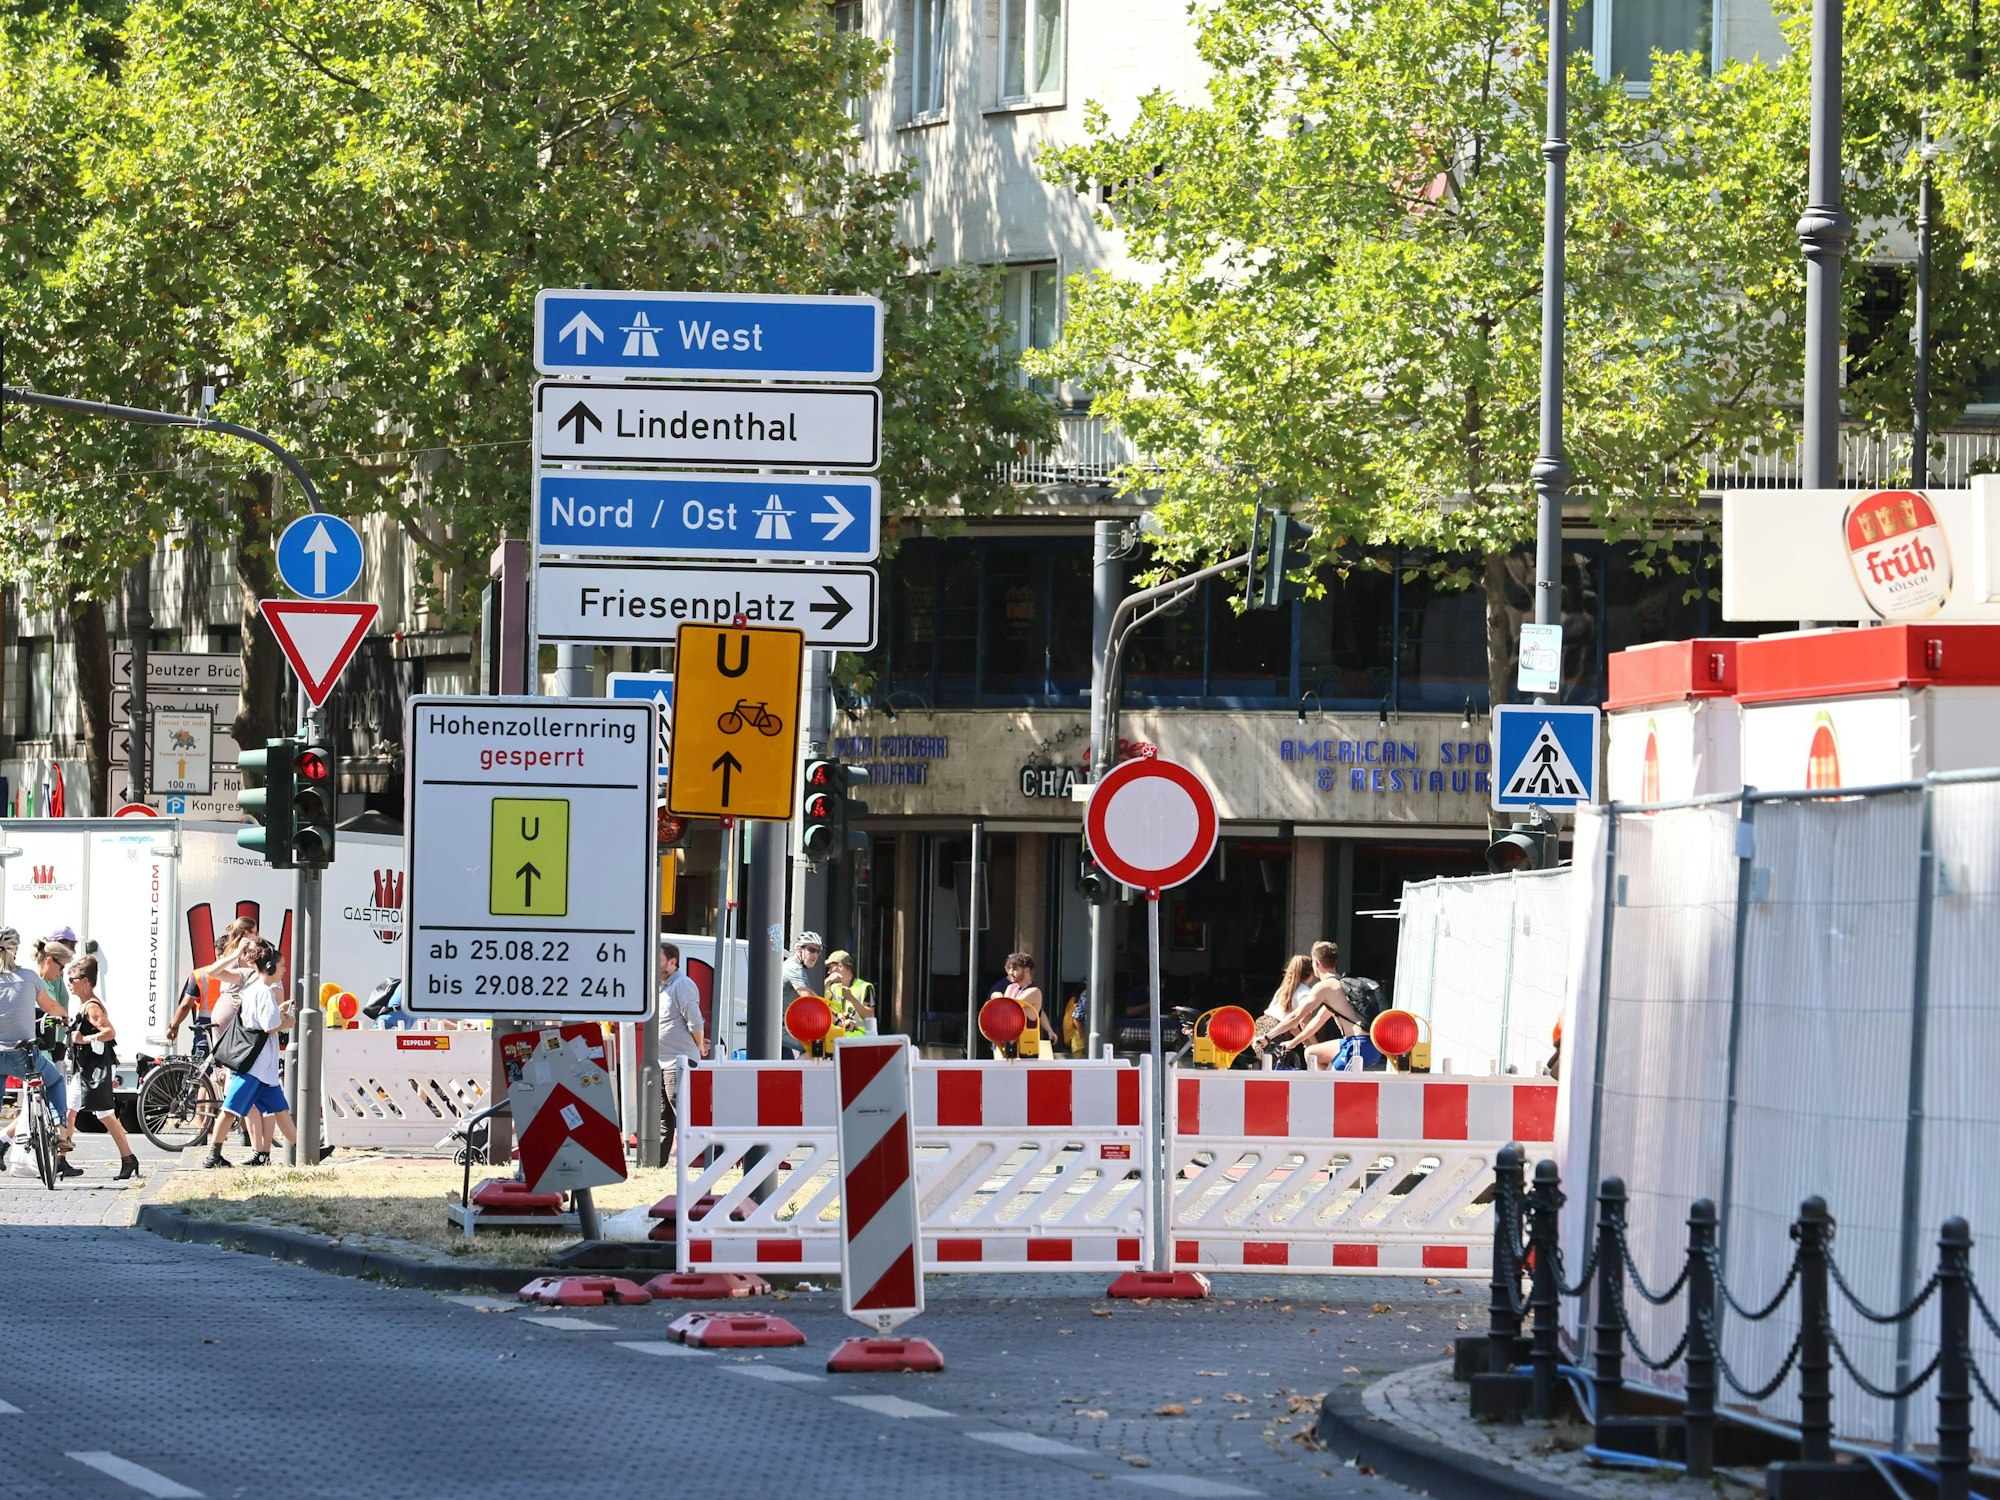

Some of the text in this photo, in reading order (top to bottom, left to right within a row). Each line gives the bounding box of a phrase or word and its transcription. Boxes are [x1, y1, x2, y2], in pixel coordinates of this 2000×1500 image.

[678, 319, 763, 351] West
[616, 408, 798, 442] Lindenthal
[551, 496, 738, 531] Nord / Ost
[1888, 574, 1929, 594] KÖLSCH
[580, 587, 795, 624] Friesenplatz
[716, 632, 750, 678] U
[147, 662, 200, 676] Deutzer
[429, 713, 636, 744] Hohenzollernring
[479, 747, 585, 771] gesperrt
[1279, 738, 1418, 765] AMERICAN
[168, 780, 184, 789] 100
[1020, 765, 1091, 798] CHA
[1317, 767, 1336, 791] &
[520, 816, 540, 842] U
[343, 906, 403, 923] GASTRO
[148, 864, 160, 1027] GASTRO-WELT.COM
[429, 939, 627, 963] ab 25.08.22 6h
[428, 973, 626, 998] bis 29.08.22 24h
